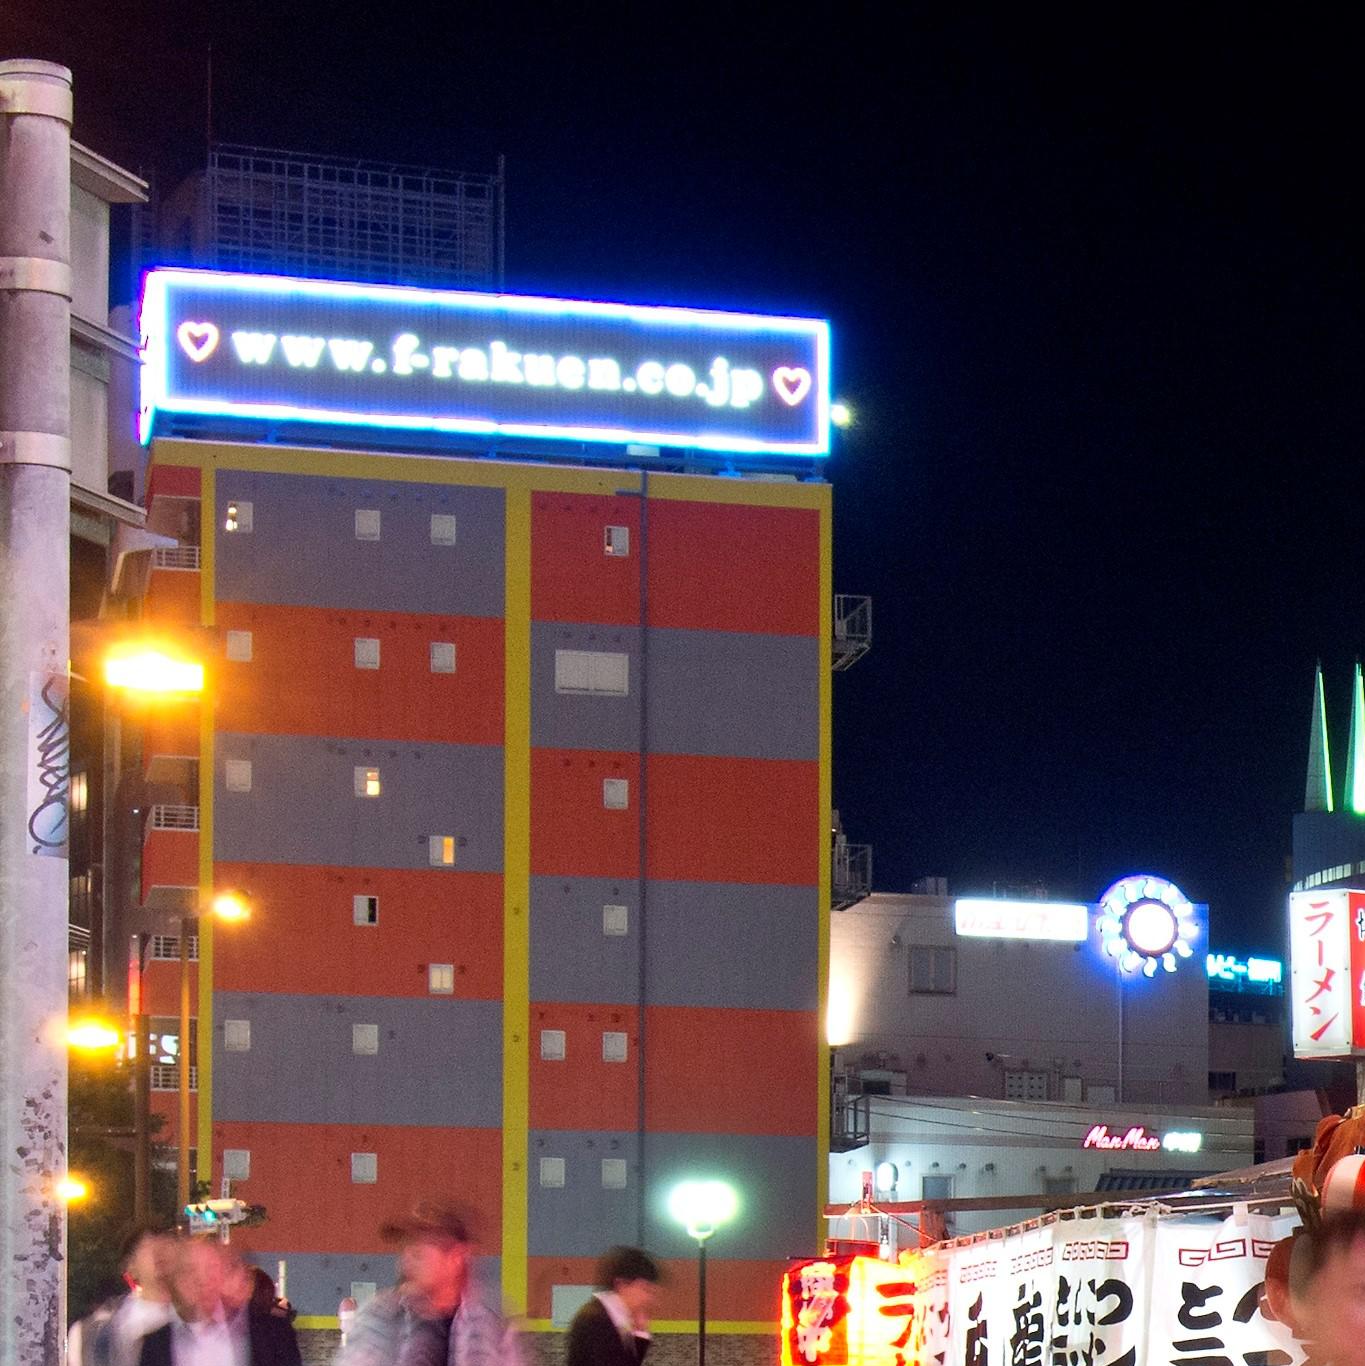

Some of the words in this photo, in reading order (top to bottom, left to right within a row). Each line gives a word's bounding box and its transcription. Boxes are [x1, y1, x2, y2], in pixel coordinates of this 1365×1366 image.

[231, 330, 763, 407] www.f-rakuen.co.jp
[1304, 901, 1339, 1042] ラーメン
